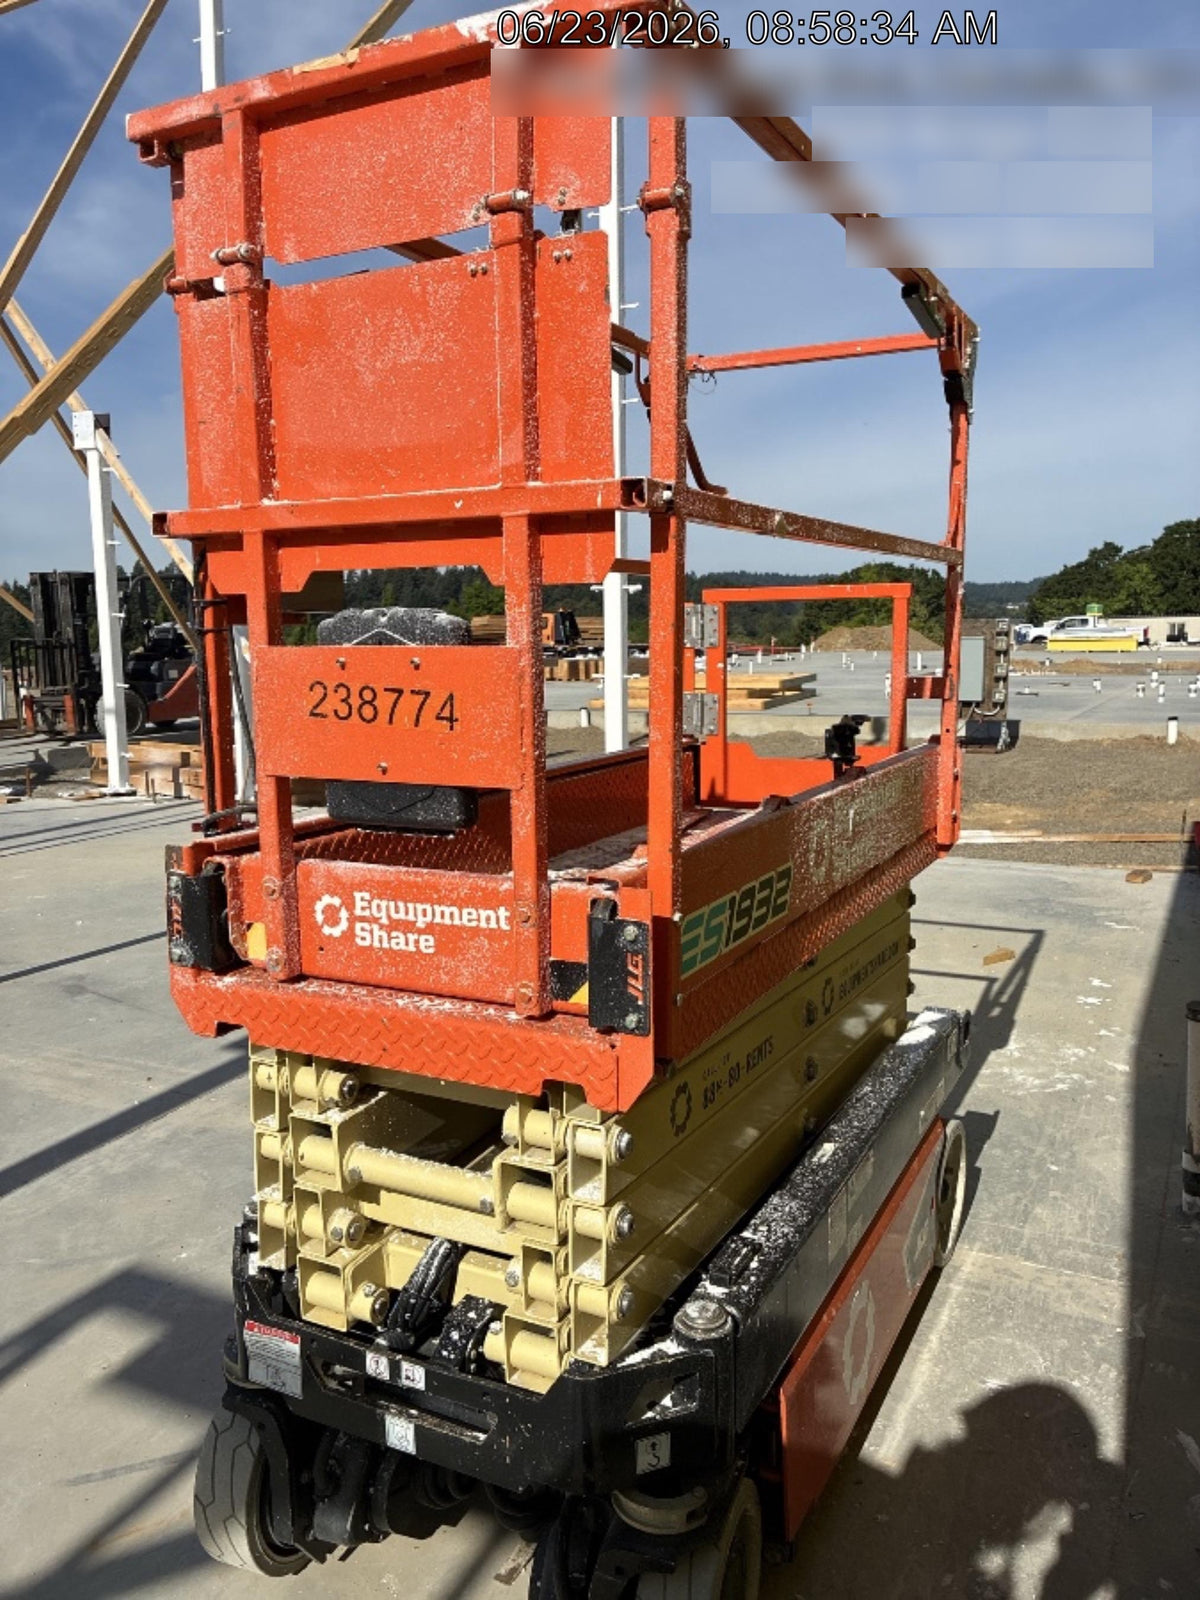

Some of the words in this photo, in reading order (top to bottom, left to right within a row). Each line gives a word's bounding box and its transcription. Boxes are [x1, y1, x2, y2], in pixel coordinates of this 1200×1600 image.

[309, 680, 459, 731] 238774
[353, 892, 511, 930] Equipment
[681, 865, 792, 977] ES1932
[354, 925, 436, 954] Share
[625, 953, 644, 1004] JLG
